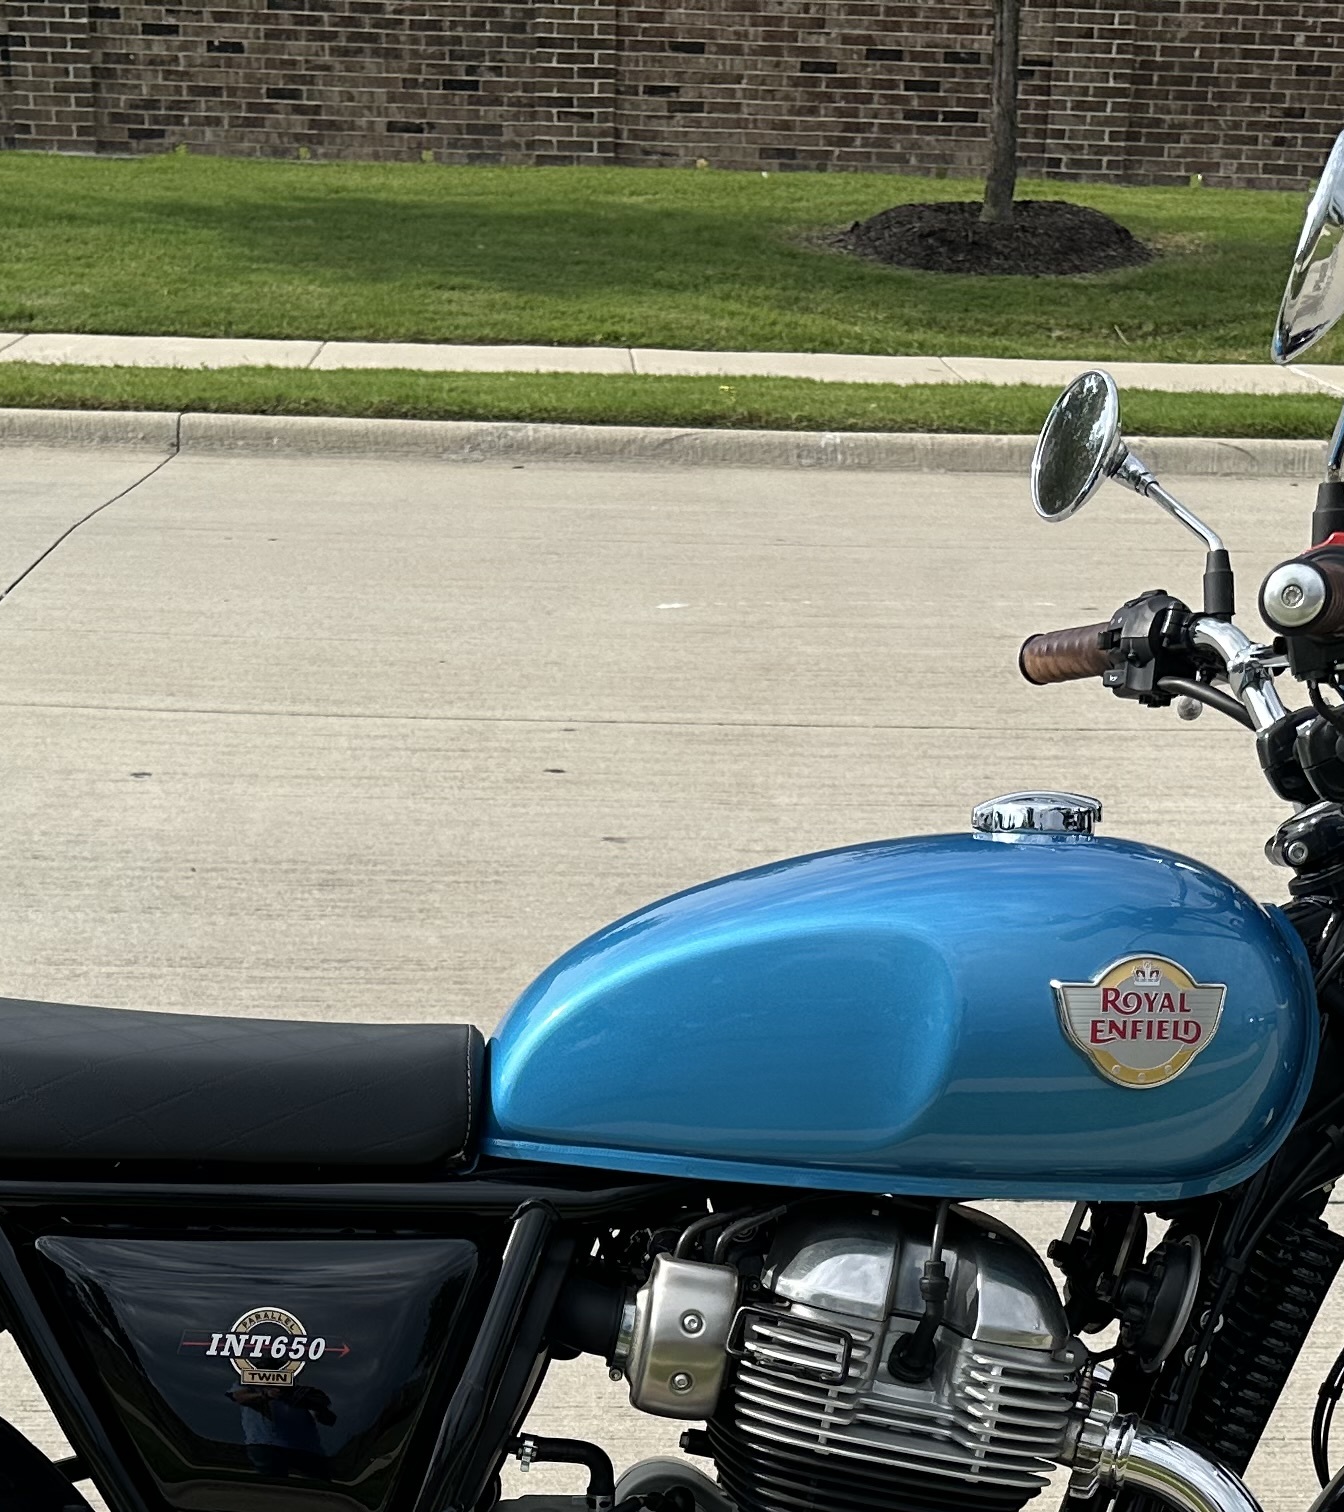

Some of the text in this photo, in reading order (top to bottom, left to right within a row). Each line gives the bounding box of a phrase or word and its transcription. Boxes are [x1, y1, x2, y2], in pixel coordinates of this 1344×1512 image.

[1101, 986, 1192, 1016] ROYAL
[1089, 1019, 1202, 1045] ENFIELD
[241, 1311, 295, 1331] PARALLEL
[206, 1332, 326, 1361] INT650
[248, 1372, 288, 1383] TWIN
